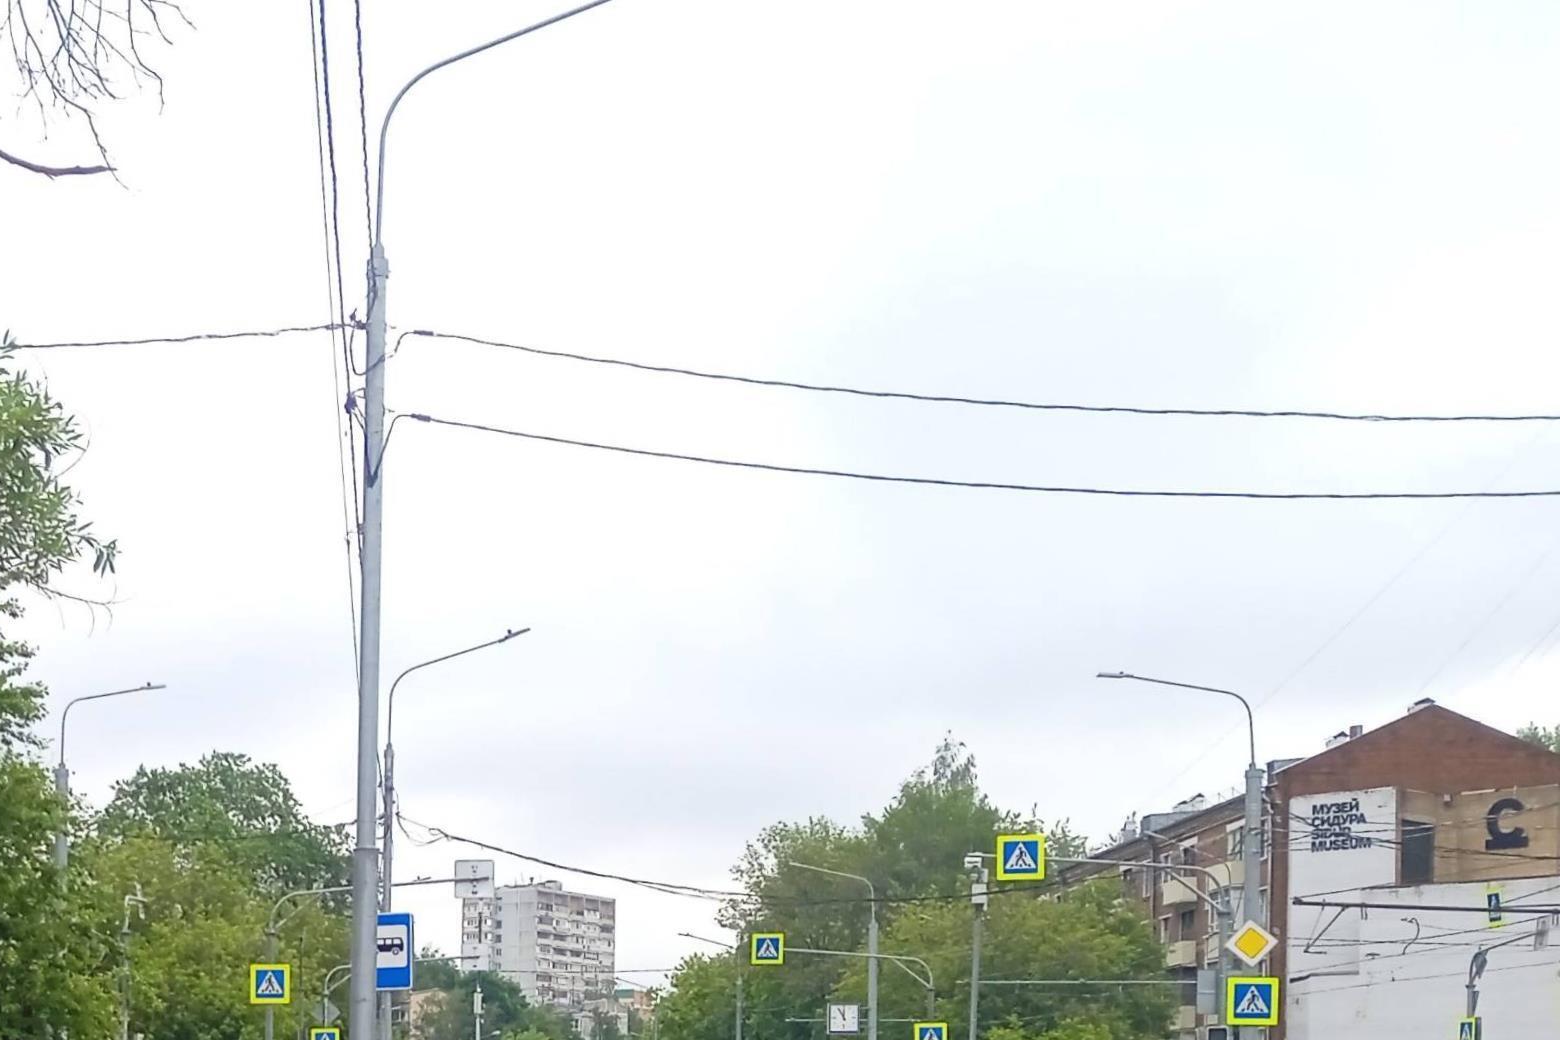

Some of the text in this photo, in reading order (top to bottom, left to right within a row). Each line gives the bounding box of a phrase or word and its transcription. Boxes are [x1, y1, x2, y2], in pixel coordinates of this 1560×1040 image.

[1311, 797, 1360, 816] МУЗЕЙ
[1311, 812, 1367, 828] СИДУРА
[1311, 836, 1372, 853] MUSEUM
